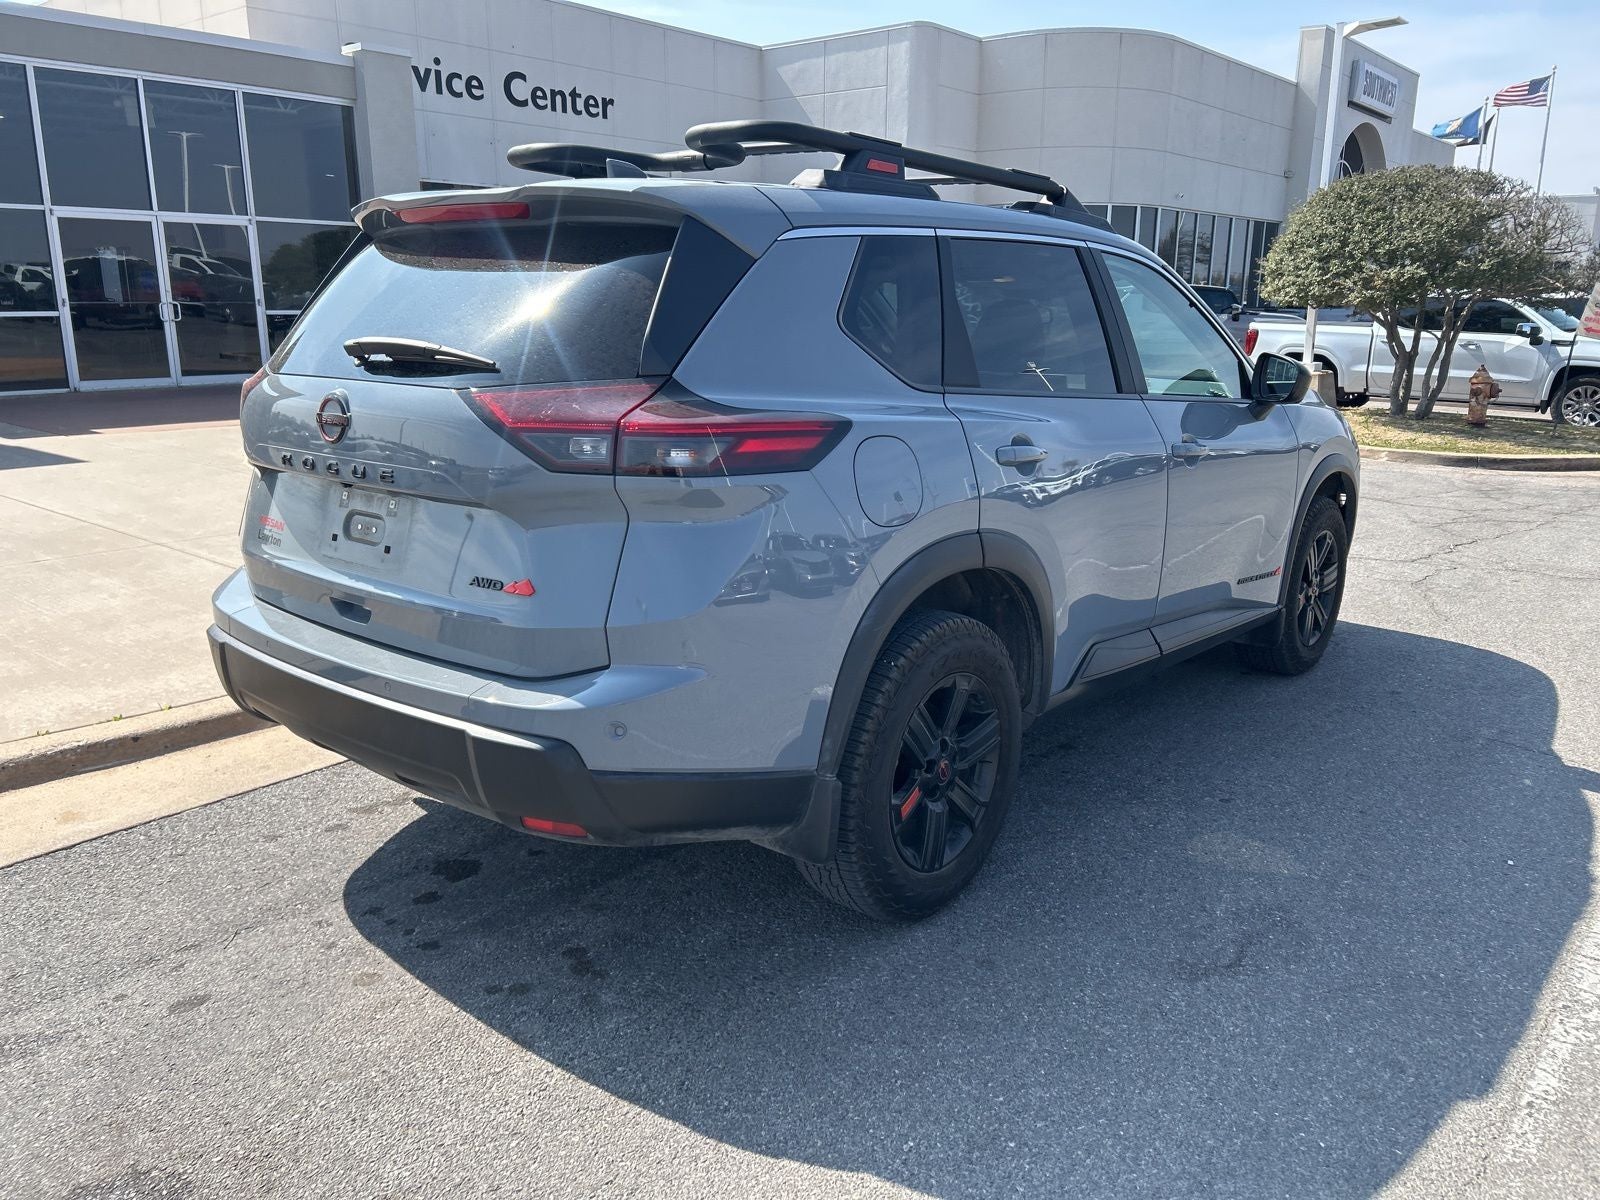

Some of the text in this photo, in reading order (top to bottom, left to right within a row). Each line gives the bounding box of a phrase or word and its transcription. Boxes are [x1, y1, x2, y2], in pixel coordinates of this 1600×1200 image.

[411, 56, 614, 119] vice Center
[281, 452, 395, 484] ROGUE
[469, 576, 504, 591] AWD
